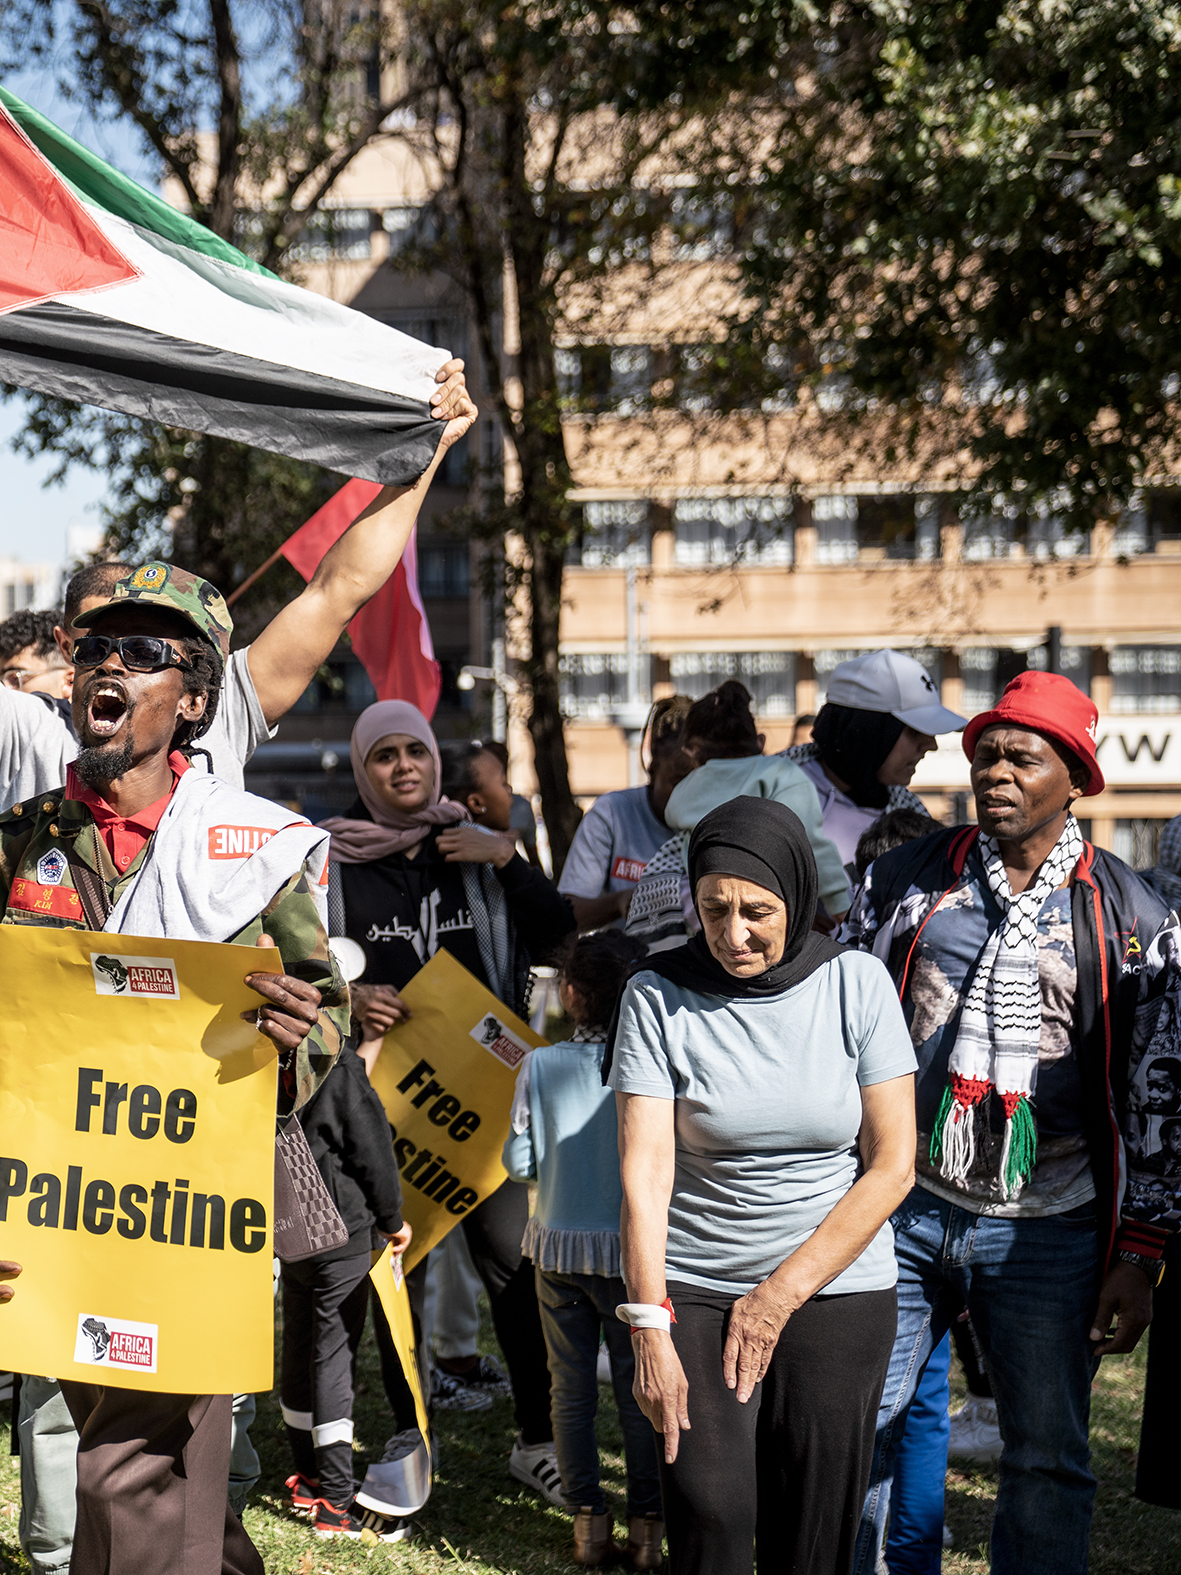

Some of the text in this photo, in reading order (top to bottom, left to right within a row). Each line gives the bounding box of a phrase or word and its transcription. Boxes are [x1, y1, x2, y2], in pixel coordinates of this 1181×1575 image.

[615, 859, 645, 880] AFRI
[33, 900, 53, 910] KIM
[131, 968, 172, 983] AFRICA
[132, 981, 173, 993] 4 PALESTINE
[75, 1067, 197, 1144] Free
[396, 1058, 481, 1143] Free
[390, 1122, 479, 1216] stine
[111, 1333, 151, 1354] AFRICA
[110, 1350, 151, 1365] 4 PALESTINE
